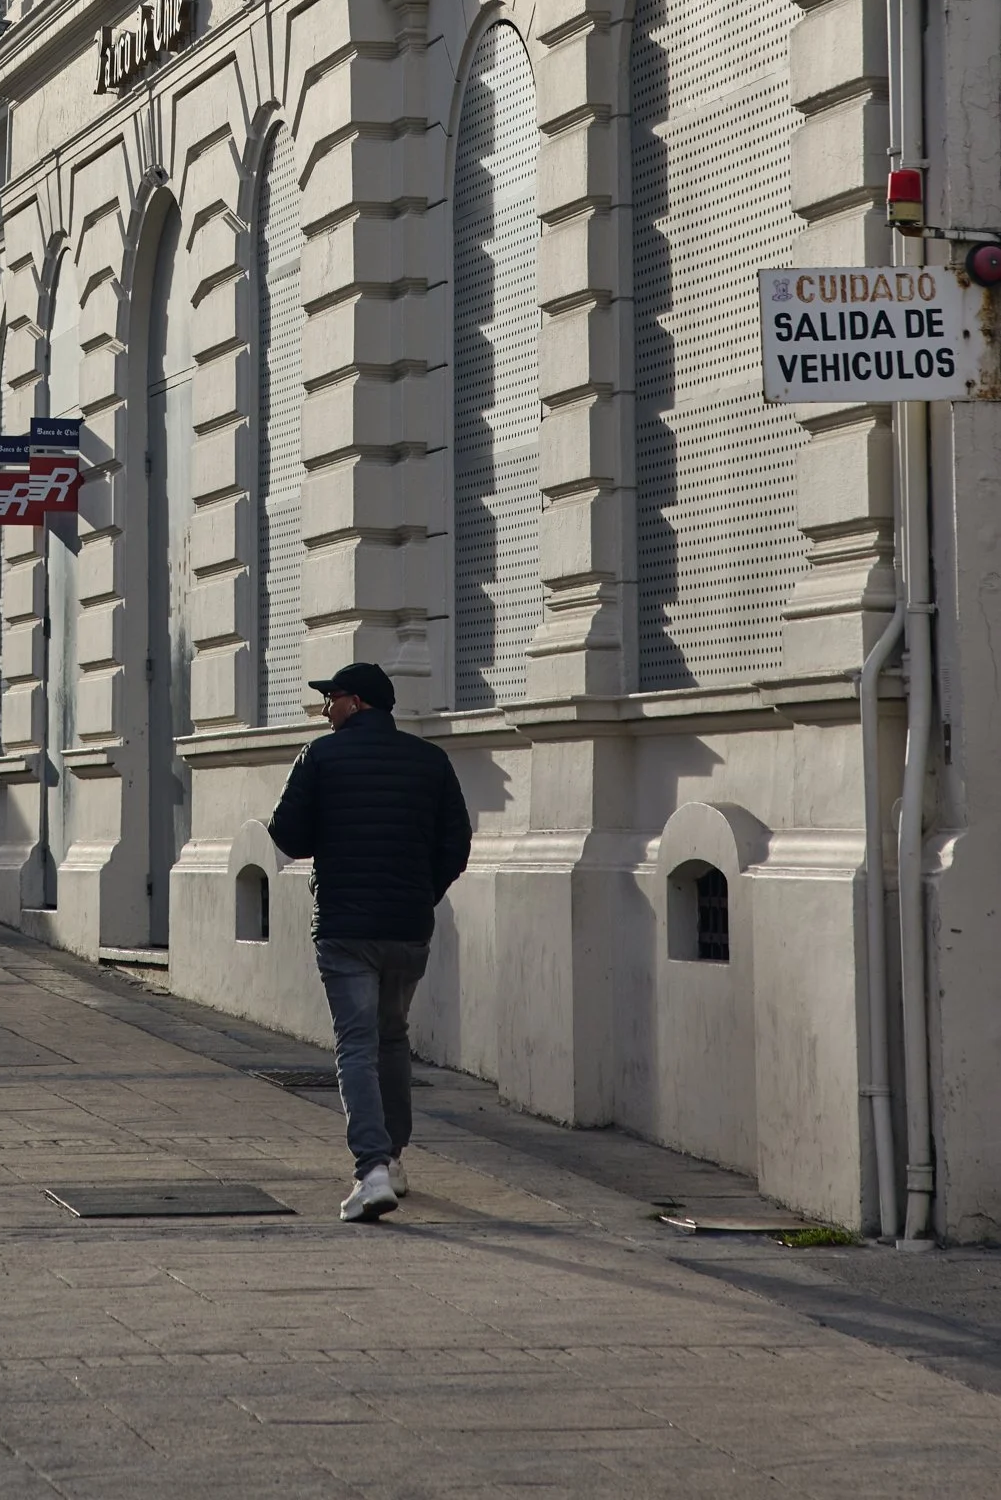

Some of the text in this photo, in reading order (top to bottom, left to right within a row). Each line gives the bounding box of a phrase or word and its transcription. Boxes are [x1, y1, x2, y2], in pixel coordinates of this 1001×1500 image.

[135, 4, 148, 65] de
[796, 272, 937, 304] CUIDADO
[774, 308, 945, 342] SALIDA DE
[777, 348, 955, 383] VEHICULOS
[37, 428, 55, 436] Banco
[64, 428, 79, 436] Chile
